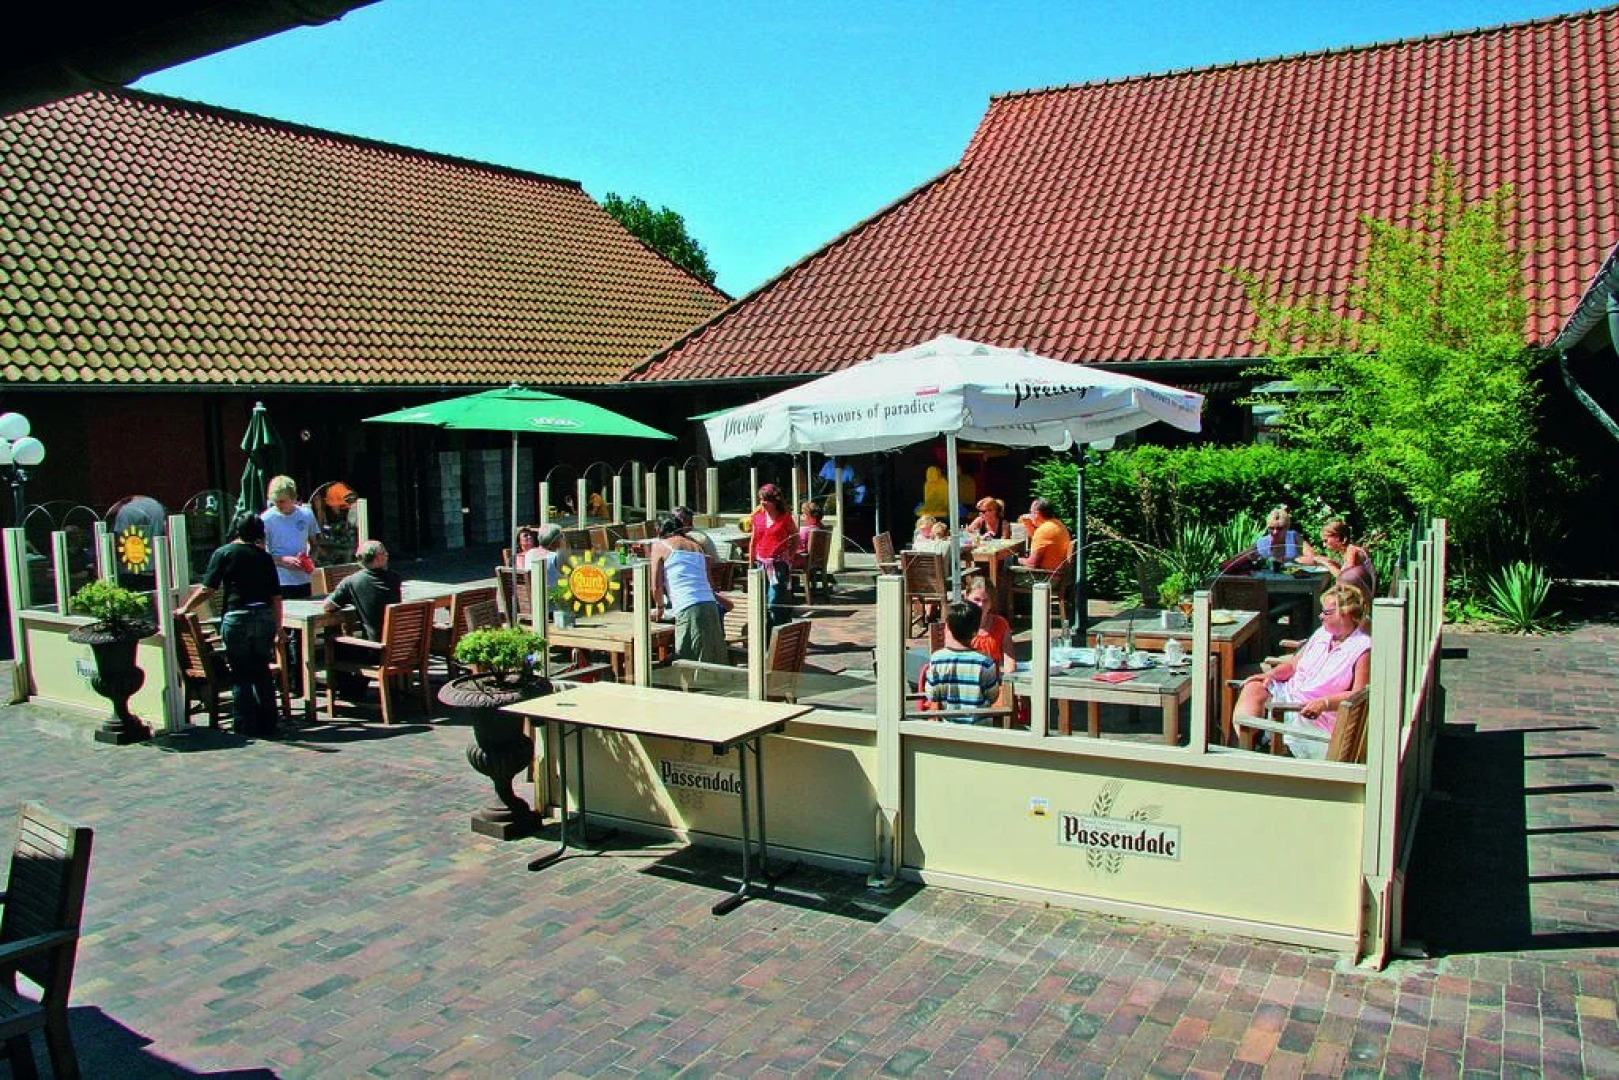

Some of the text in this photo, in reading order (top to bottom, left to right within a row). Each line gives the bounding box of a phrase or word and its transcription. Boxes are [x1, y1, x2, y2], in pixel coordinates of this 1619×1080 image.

[812, 398, 936, 425] Flavours of paradice
[660, 760, 741, 794] Passendale
[1063, 815, 1176, 856] Passendale
